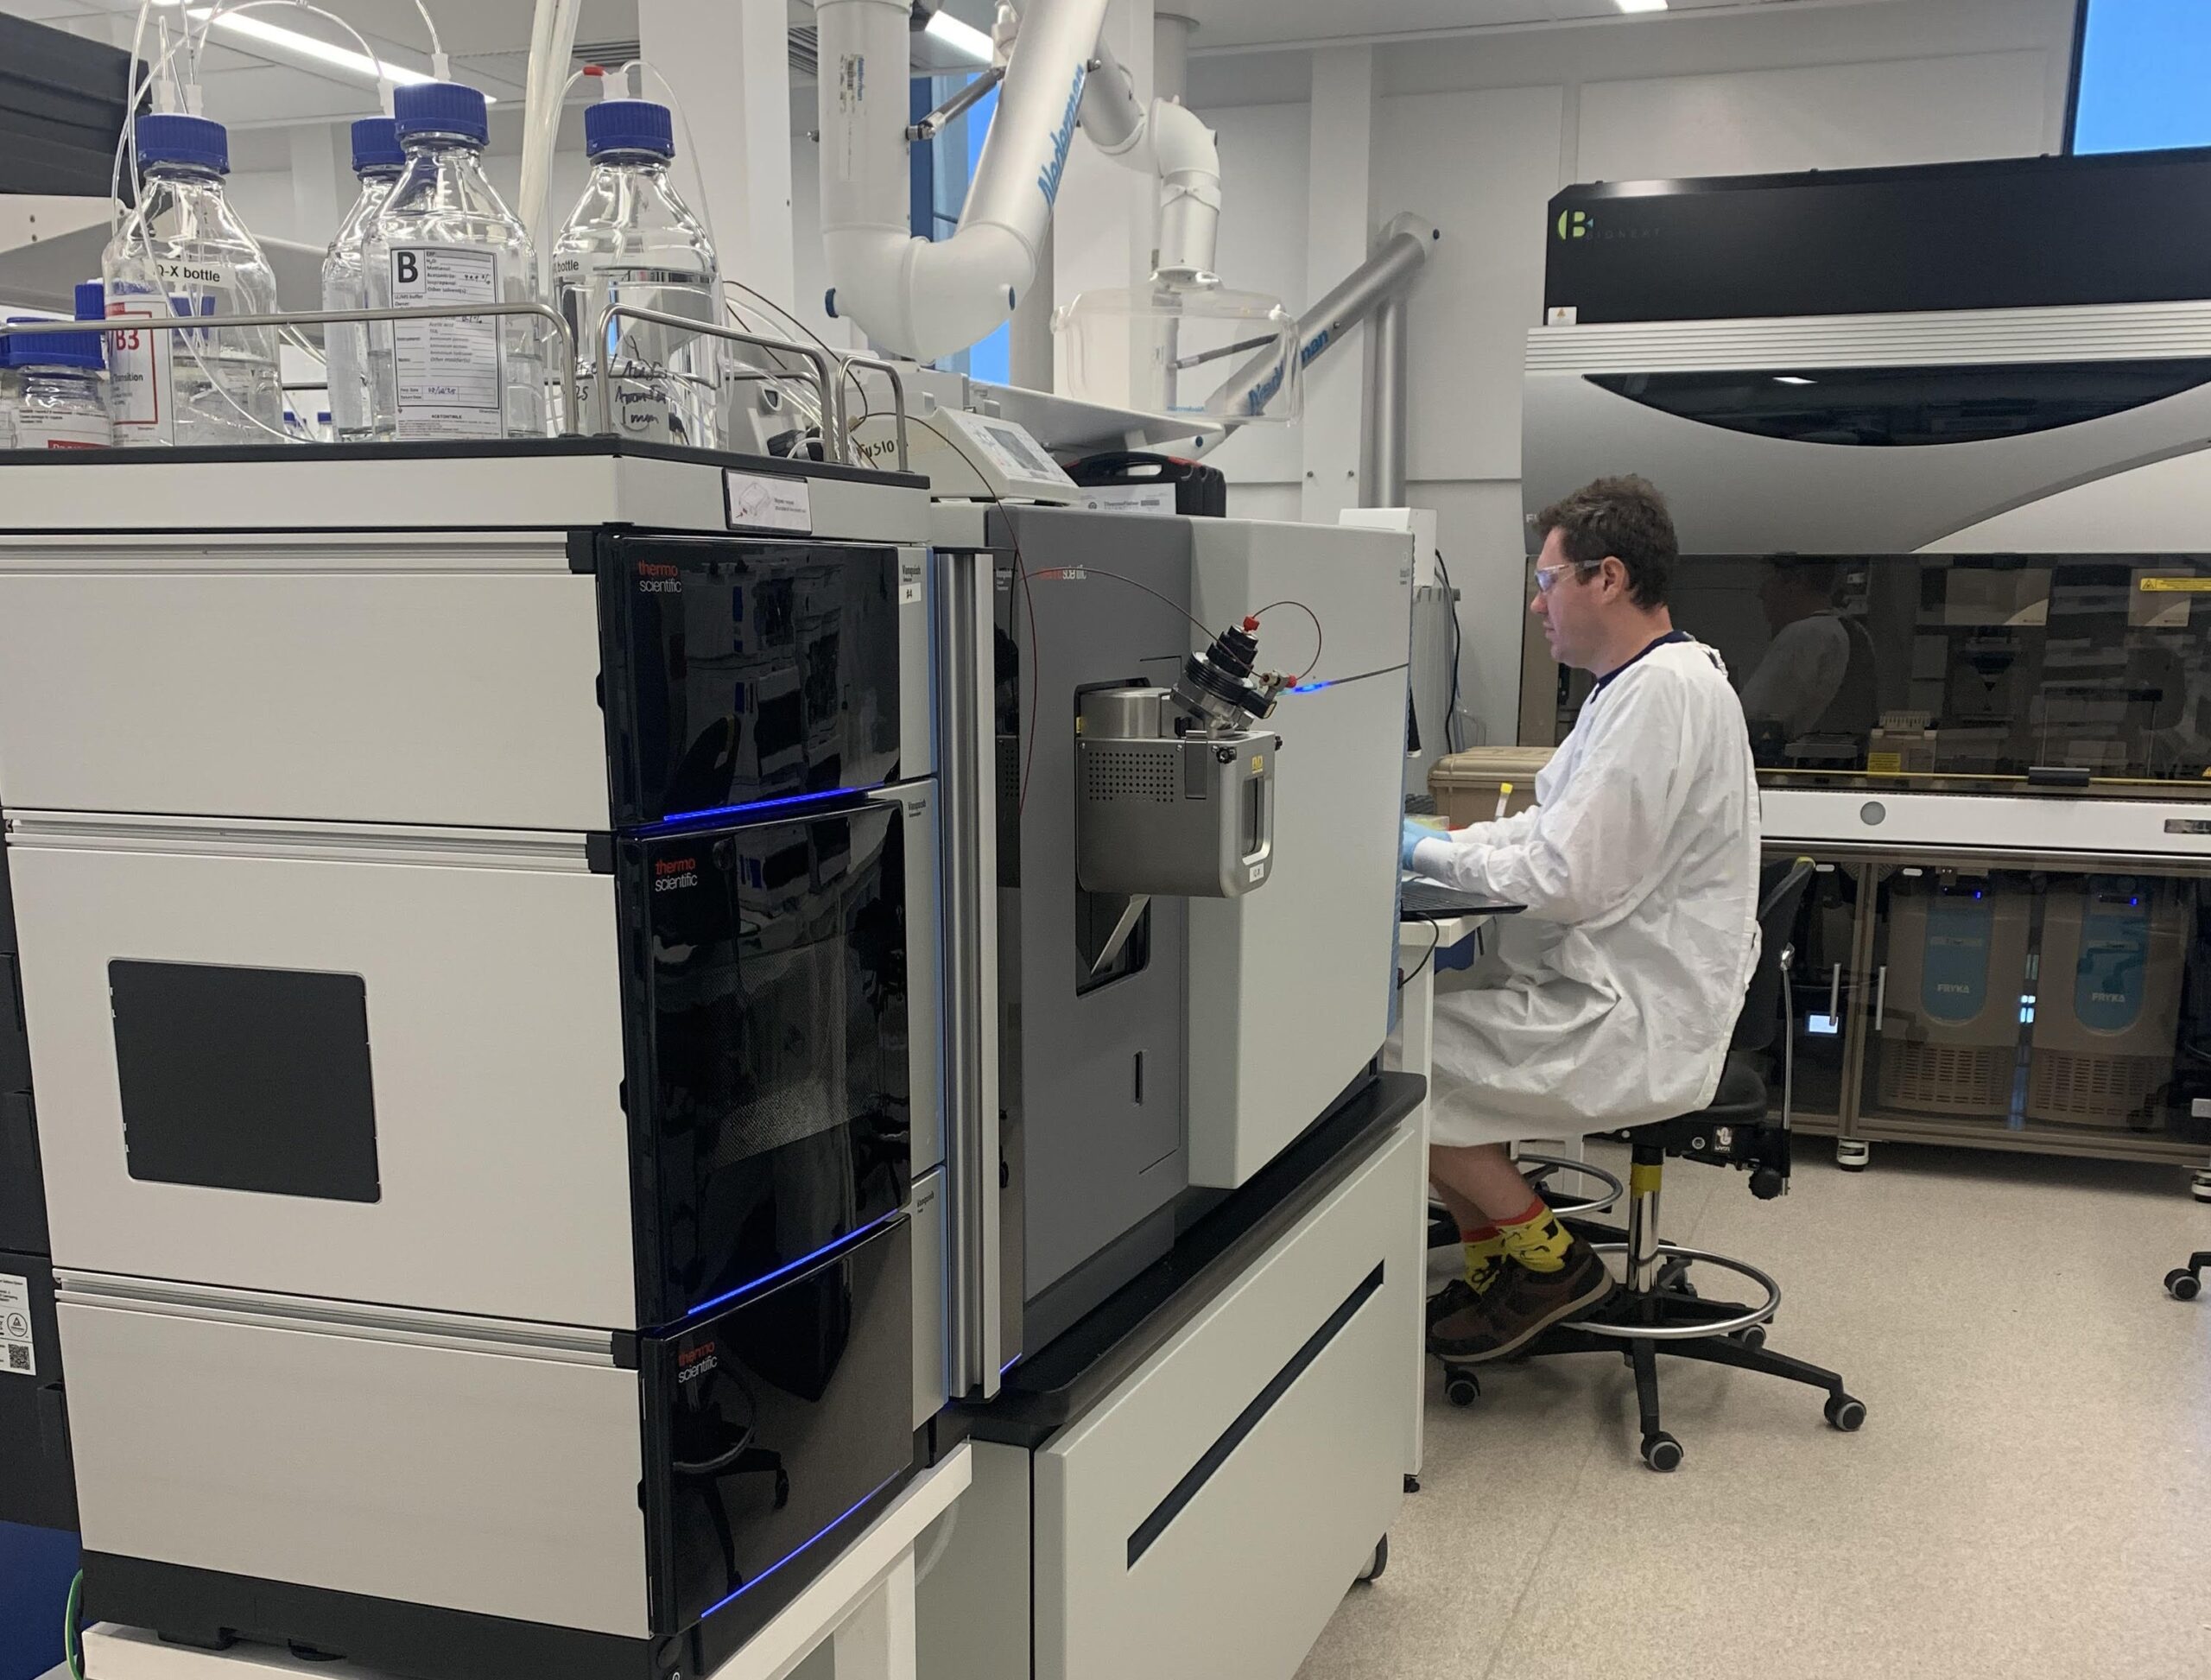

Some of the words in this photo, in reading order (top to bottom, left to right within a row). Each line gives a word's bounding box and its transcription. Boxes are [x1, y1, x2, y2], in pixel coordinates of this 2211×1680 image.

[397, 251, 419, 283] B
[557, 259, 580, 273] bottle
[184, 266, 221, 282] bottle
[639, 561, 678, 576] thermo
[639, 578, 682, 593] scientific
[656, 859, 695, 874] thermo
[655, 872, 698, 891] scientific
[678, 1355, 718, 1383] scientific
